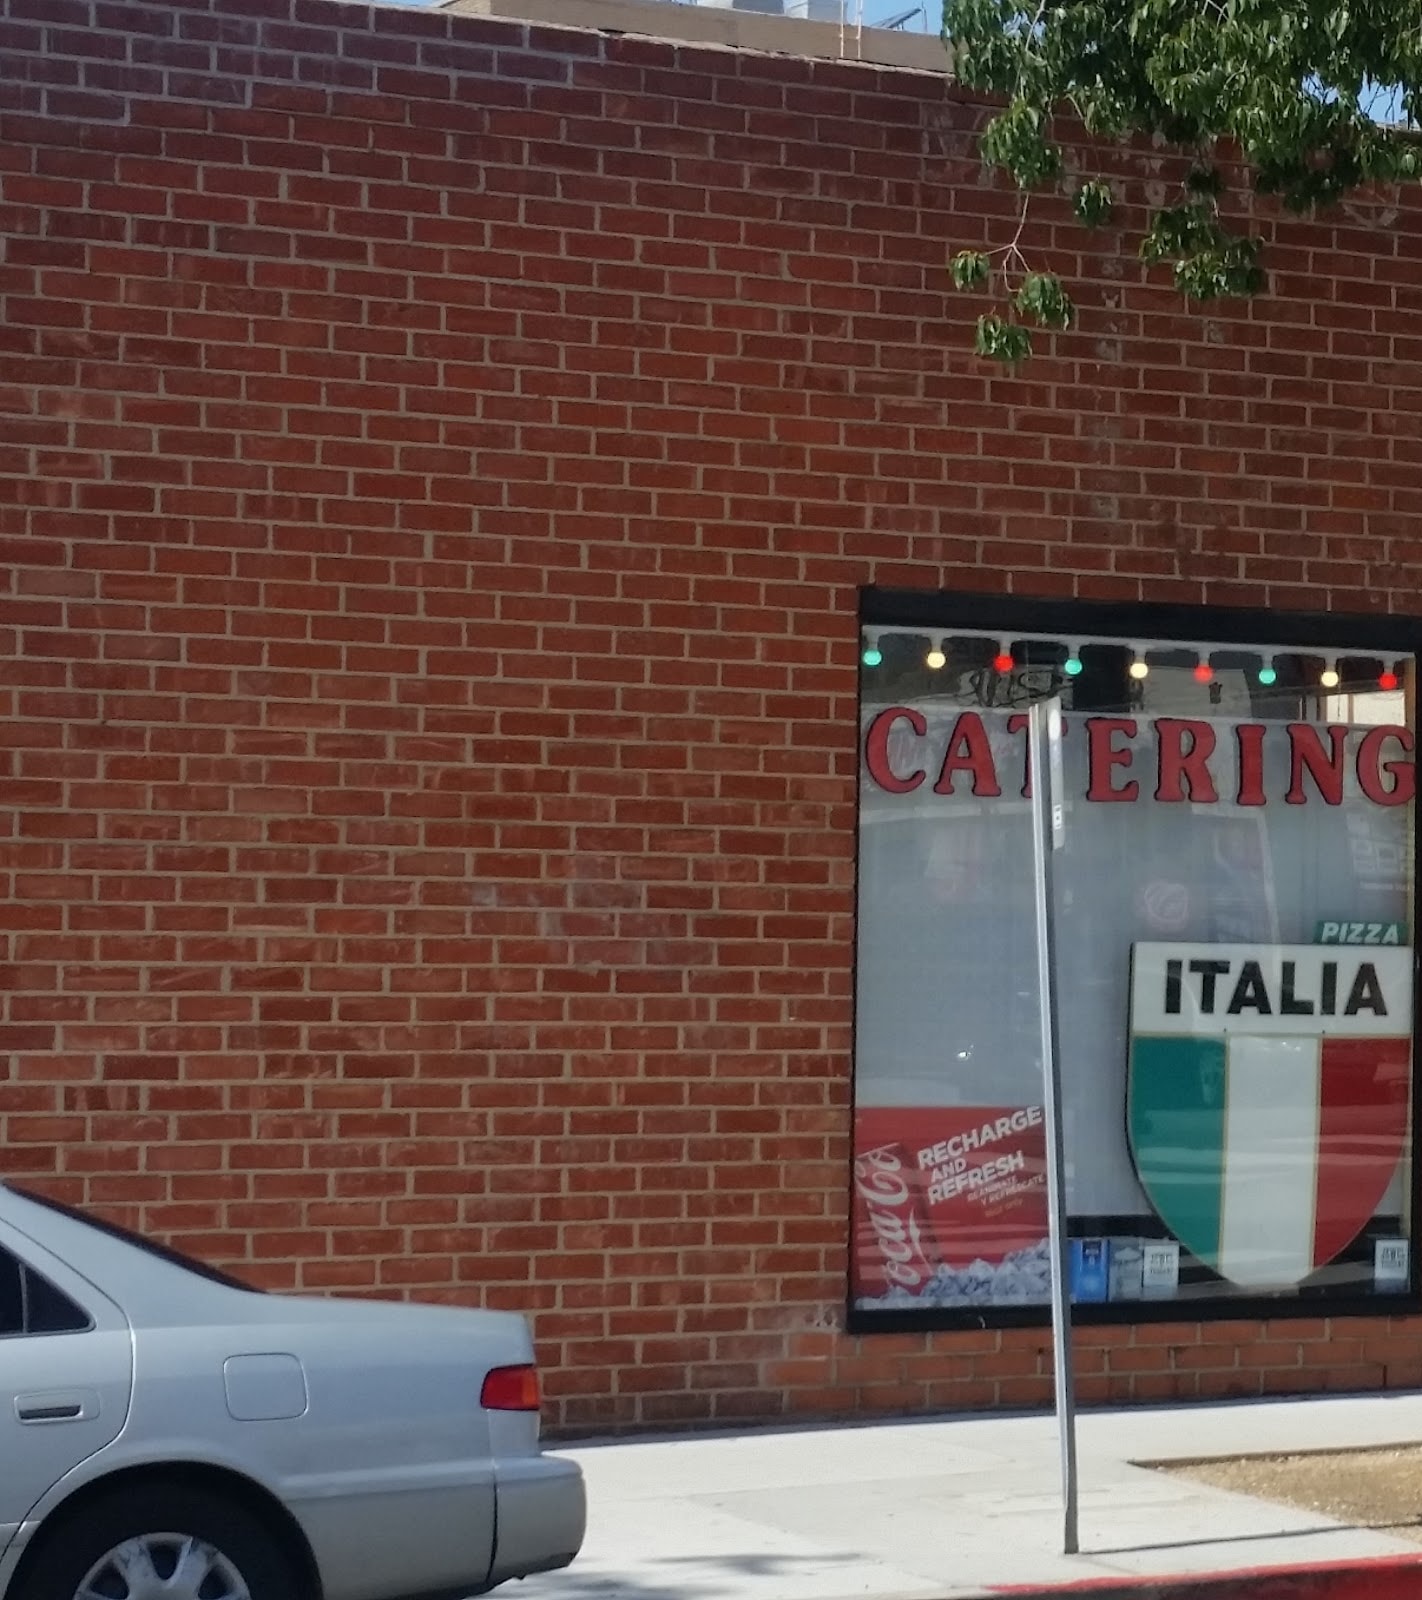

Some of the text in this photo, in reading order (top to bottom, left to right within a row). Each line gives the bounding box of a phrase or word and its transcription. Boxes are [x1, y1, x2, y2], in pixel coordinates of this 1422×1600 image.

[1321, 922, 1400, 944] PIZZA
[1165, 959, 1388, 1015] ITALIA
[917, 1105, 1042, 1171] RECHARGE
[927, 1150, 1025, 1206] REFRESH
[931, 1158, 966, 1183] AND
